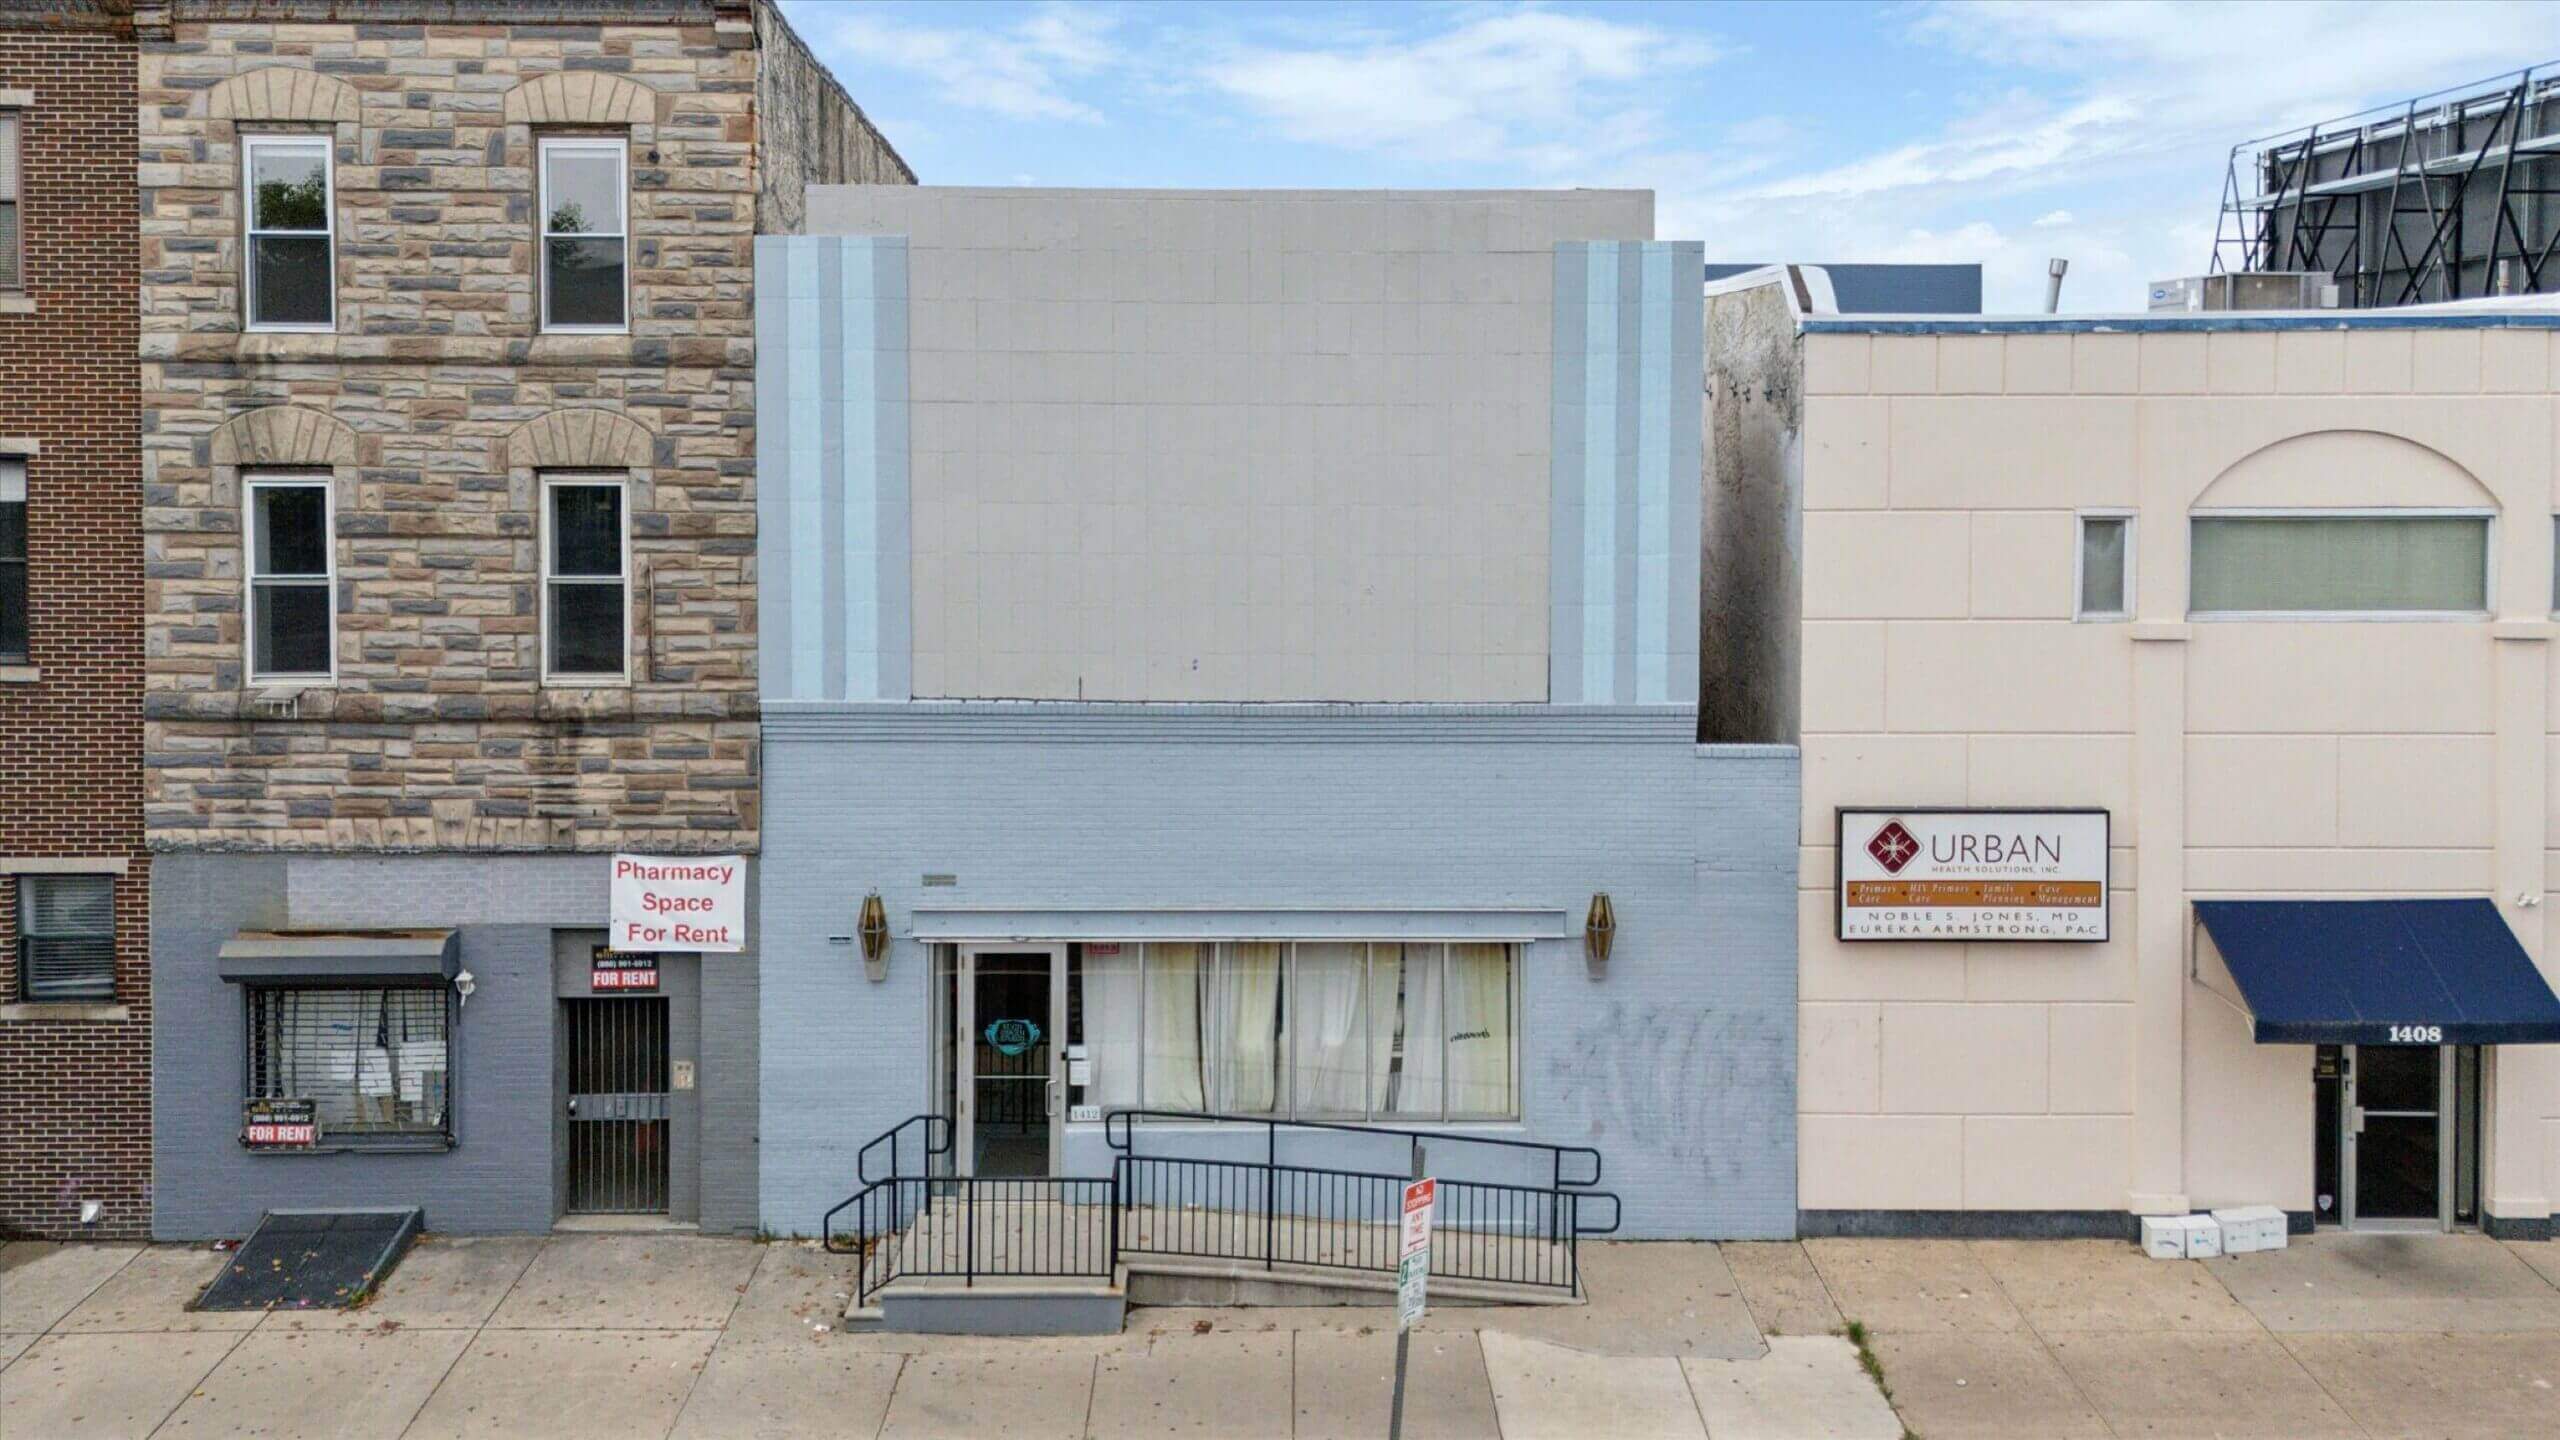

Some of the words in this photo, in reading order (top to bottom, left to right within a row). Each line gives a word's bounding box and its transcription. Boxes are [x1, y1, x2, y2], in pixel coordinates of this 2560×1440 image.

[1932, 834, 2061, 863] URBAN
[617, 860, 734, 884] Pharmacy
[1860, 884, 1897, 894] Primary
[642, 892, 714, 914] Space
[1859, 895, 1881, 904] Care
[1909, 894, 1931, 903] Care
[1983, 894, 2025, 905] Planning
[2039, 895, 2097, 905] Management
[1868, 912, 1933, 921] NOBLE
[1972, 912, 2040, 922] JONES,
[2052, 912, 2079, 921] MD
[628, 924, 667, 942] For
[674, 924, 729, 943] Rent
[1849, 925, 1921, 934] EUREKA
[1932, 925, 2057, 935] ARMSTRONG,
[593, 971, 619, 987] FOR
[622, 970, 657, 986] RENT
[2389, 1026, 2442, 1042] 1408
[249, 1126, 274, 1141] FOR
[277, 1126, 314, 1141] RENT
